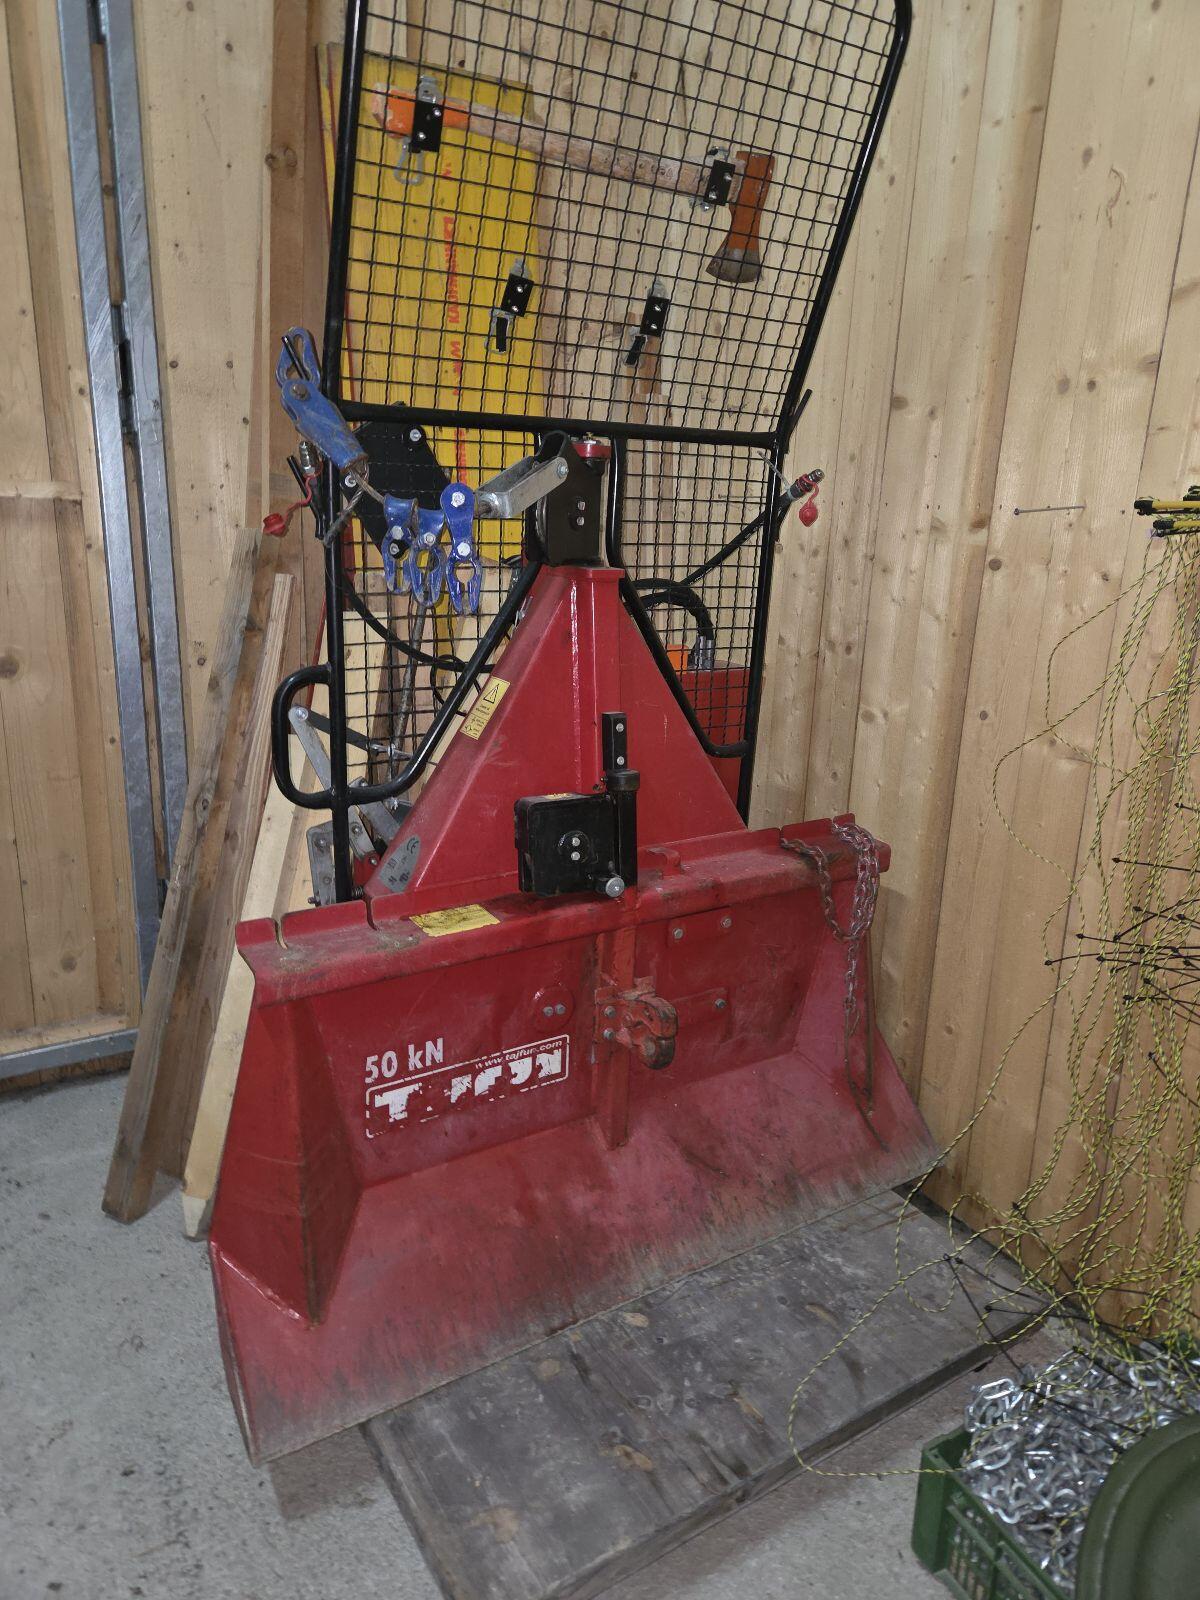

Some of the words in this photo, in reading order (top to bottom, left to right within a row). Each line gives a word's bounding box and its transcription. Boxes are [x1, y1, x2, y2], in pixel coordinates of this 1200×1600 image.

[365, 1050, 398, 1084] 50
[408, 1037, 444, 1072] kN
[475, 1040, 563, 1070] wwwtajfun.com
